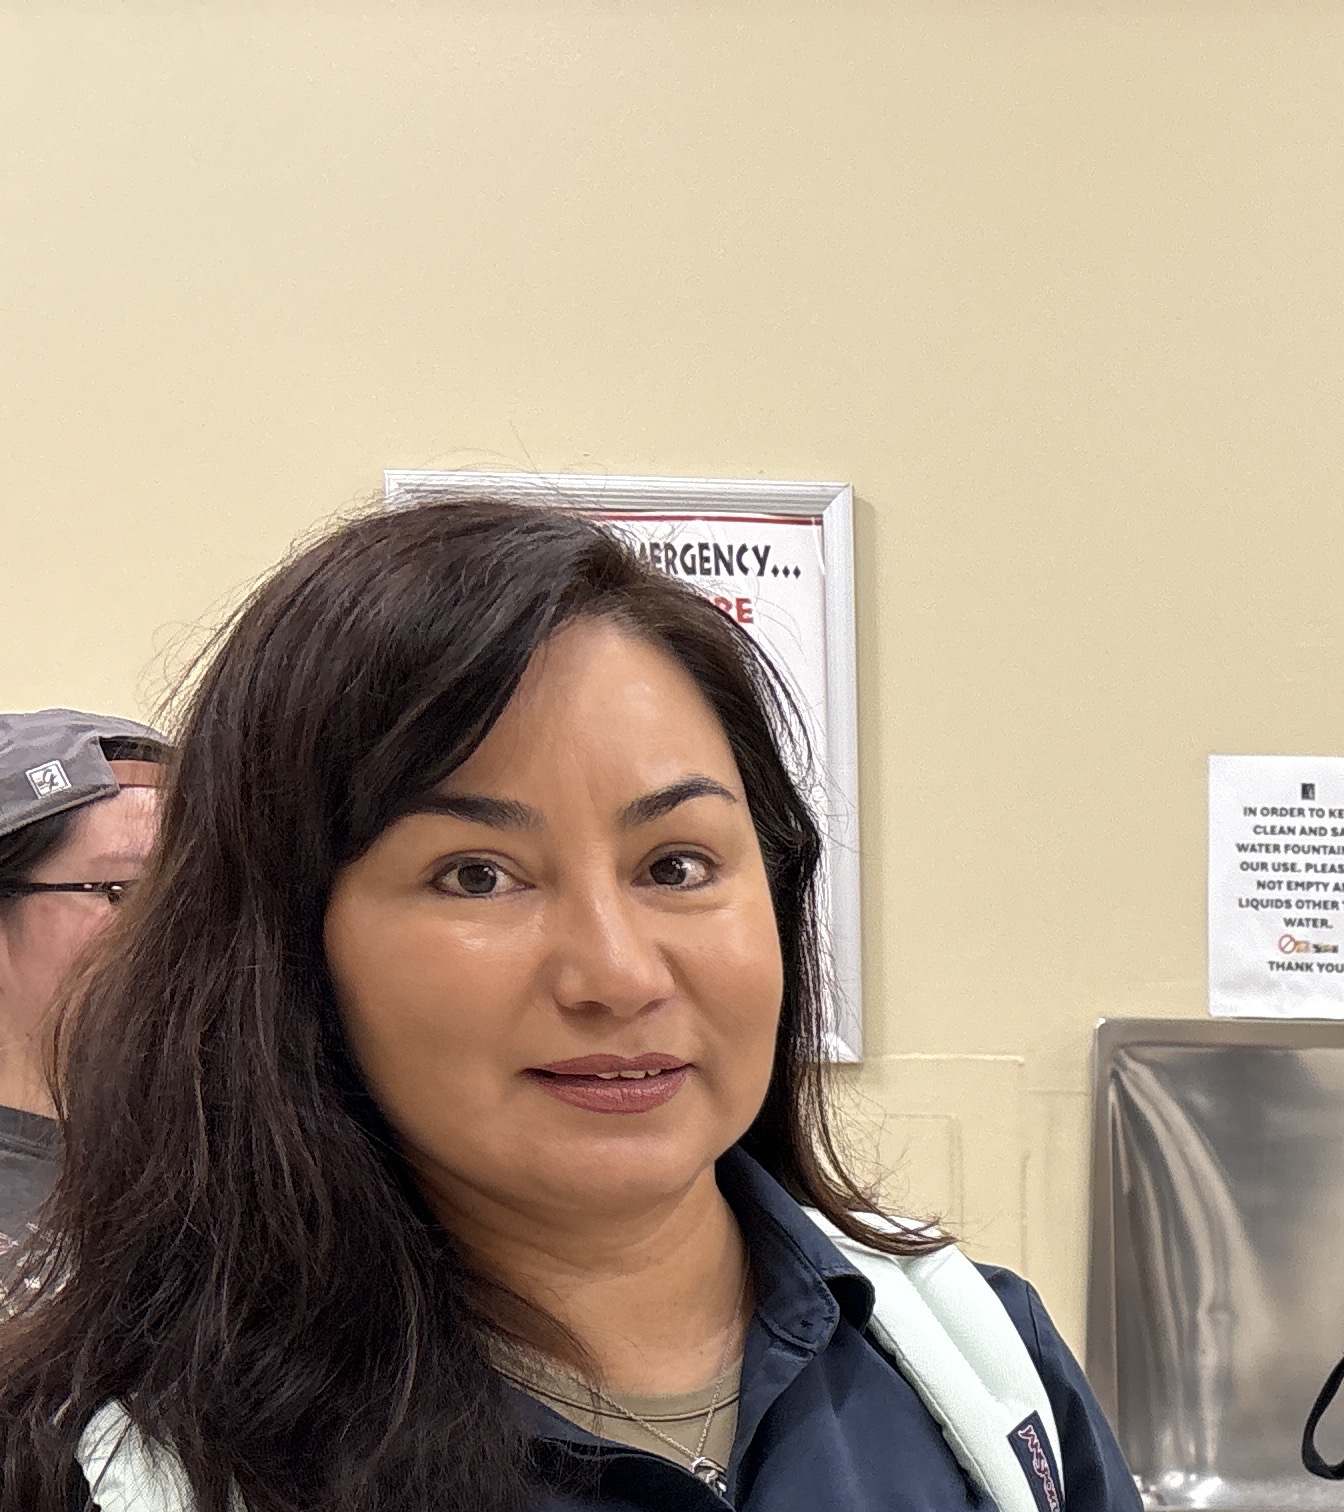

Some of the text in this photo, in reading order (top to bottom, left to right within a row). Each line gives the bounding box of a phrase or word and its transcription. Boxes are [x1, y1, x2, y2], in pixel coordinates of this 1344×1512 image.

[1243, 806, 1257, 817] IN
[1260, 806, 1306, 818] ORDER
[1308, 807, 1325, 818] TO
[1253, 824, 1296, 836] CLEAN
[1299, 826, 1328, 837] AND
[1235, 842, 1281, 854] WATER
[1239, 861, 1269, 872] OUR
[1271, 862, 1301, 873] USE.
[1256, 880, 1283, 891] NOT
[1286, 880, 1330, 892] EMPTY
[1238, 897, 1292, 911] LIQUIDS
[1295, 899, 1339, 910] OTHER
[1283, 917, 1333, 928] WATER.
[1267, 960, 1314, 973] THANK
